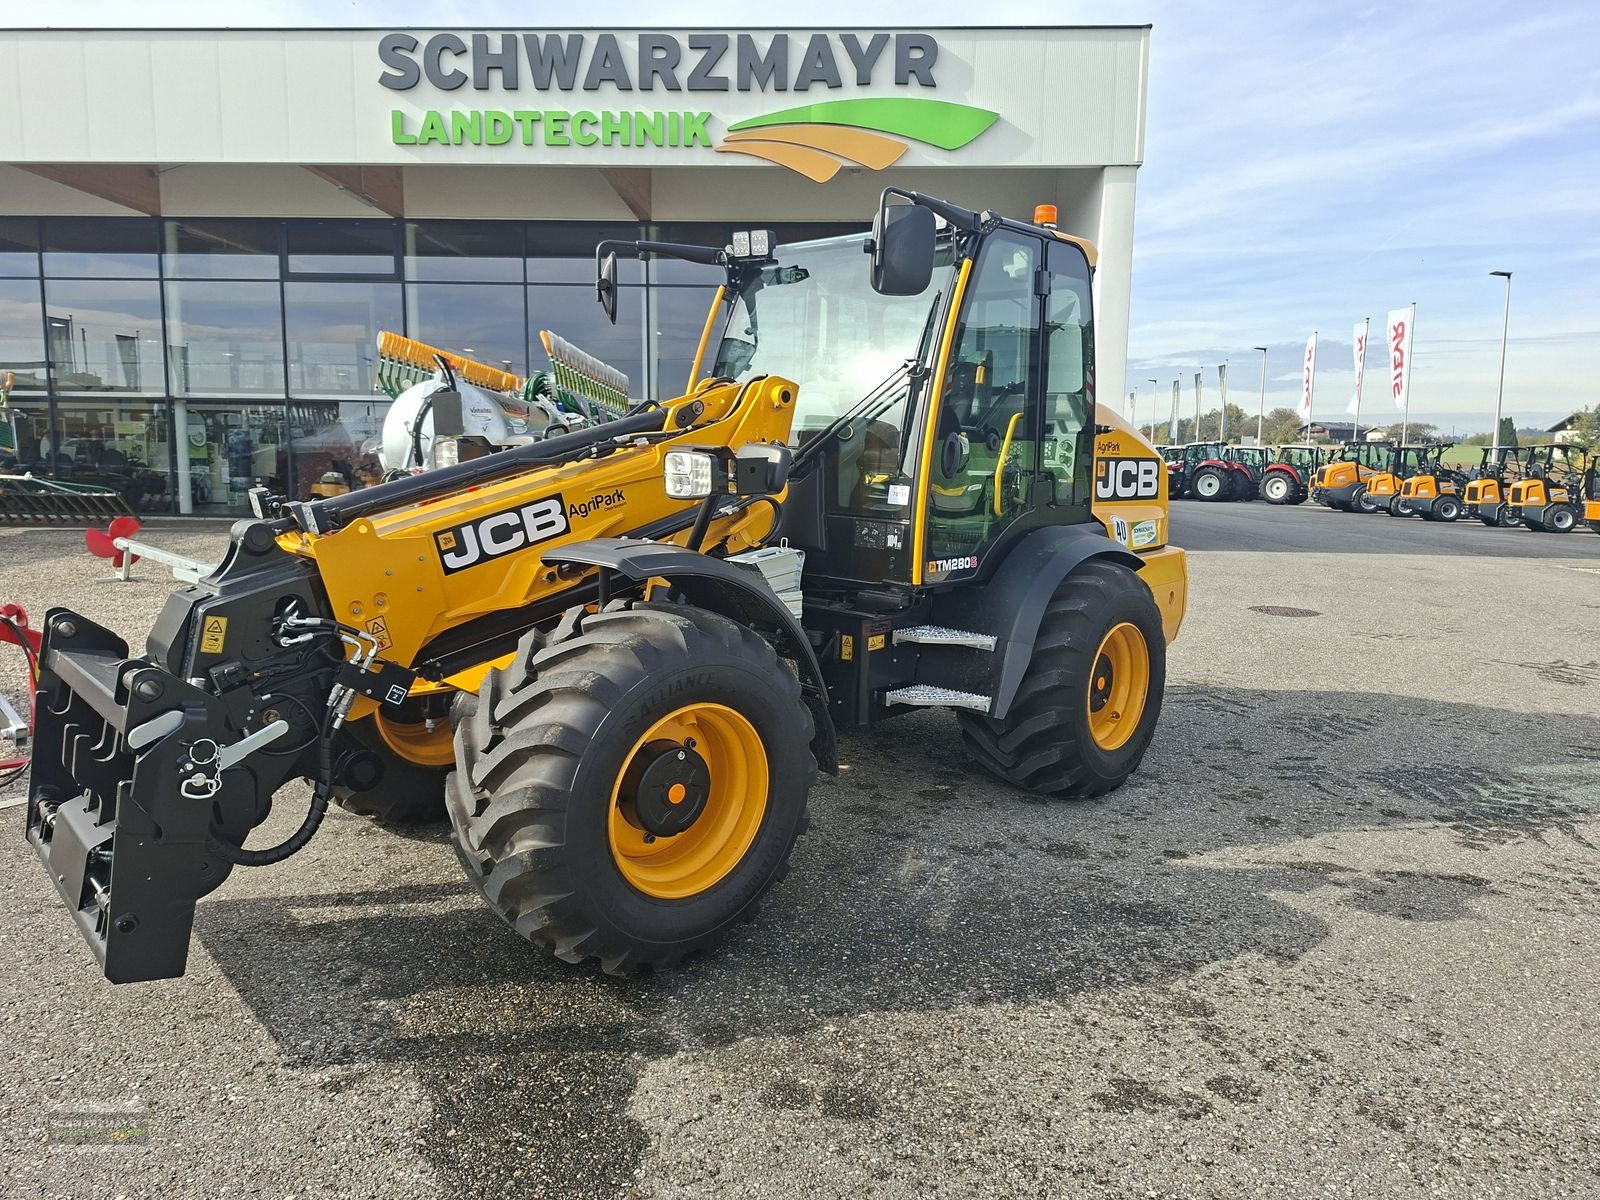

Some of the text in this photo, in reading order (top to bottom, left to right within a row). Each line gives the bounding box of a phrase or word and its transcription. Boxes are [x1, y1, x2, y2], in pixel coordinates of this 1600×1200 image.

[378, 33, 938, 92] SCHWARZMAYR
[391, 109, 712, 147] LANDTECHNIK
[1097, 441, 1120, 454] AgriPark
[1097, 461, 1158, 498] JCB
[569, 489, 625, 518] AgriPark
[443, 499, 567, 569] JCB
[1116, 520, 1127, 542] 40
[640, 671, 717, 720] ALLIANCE
